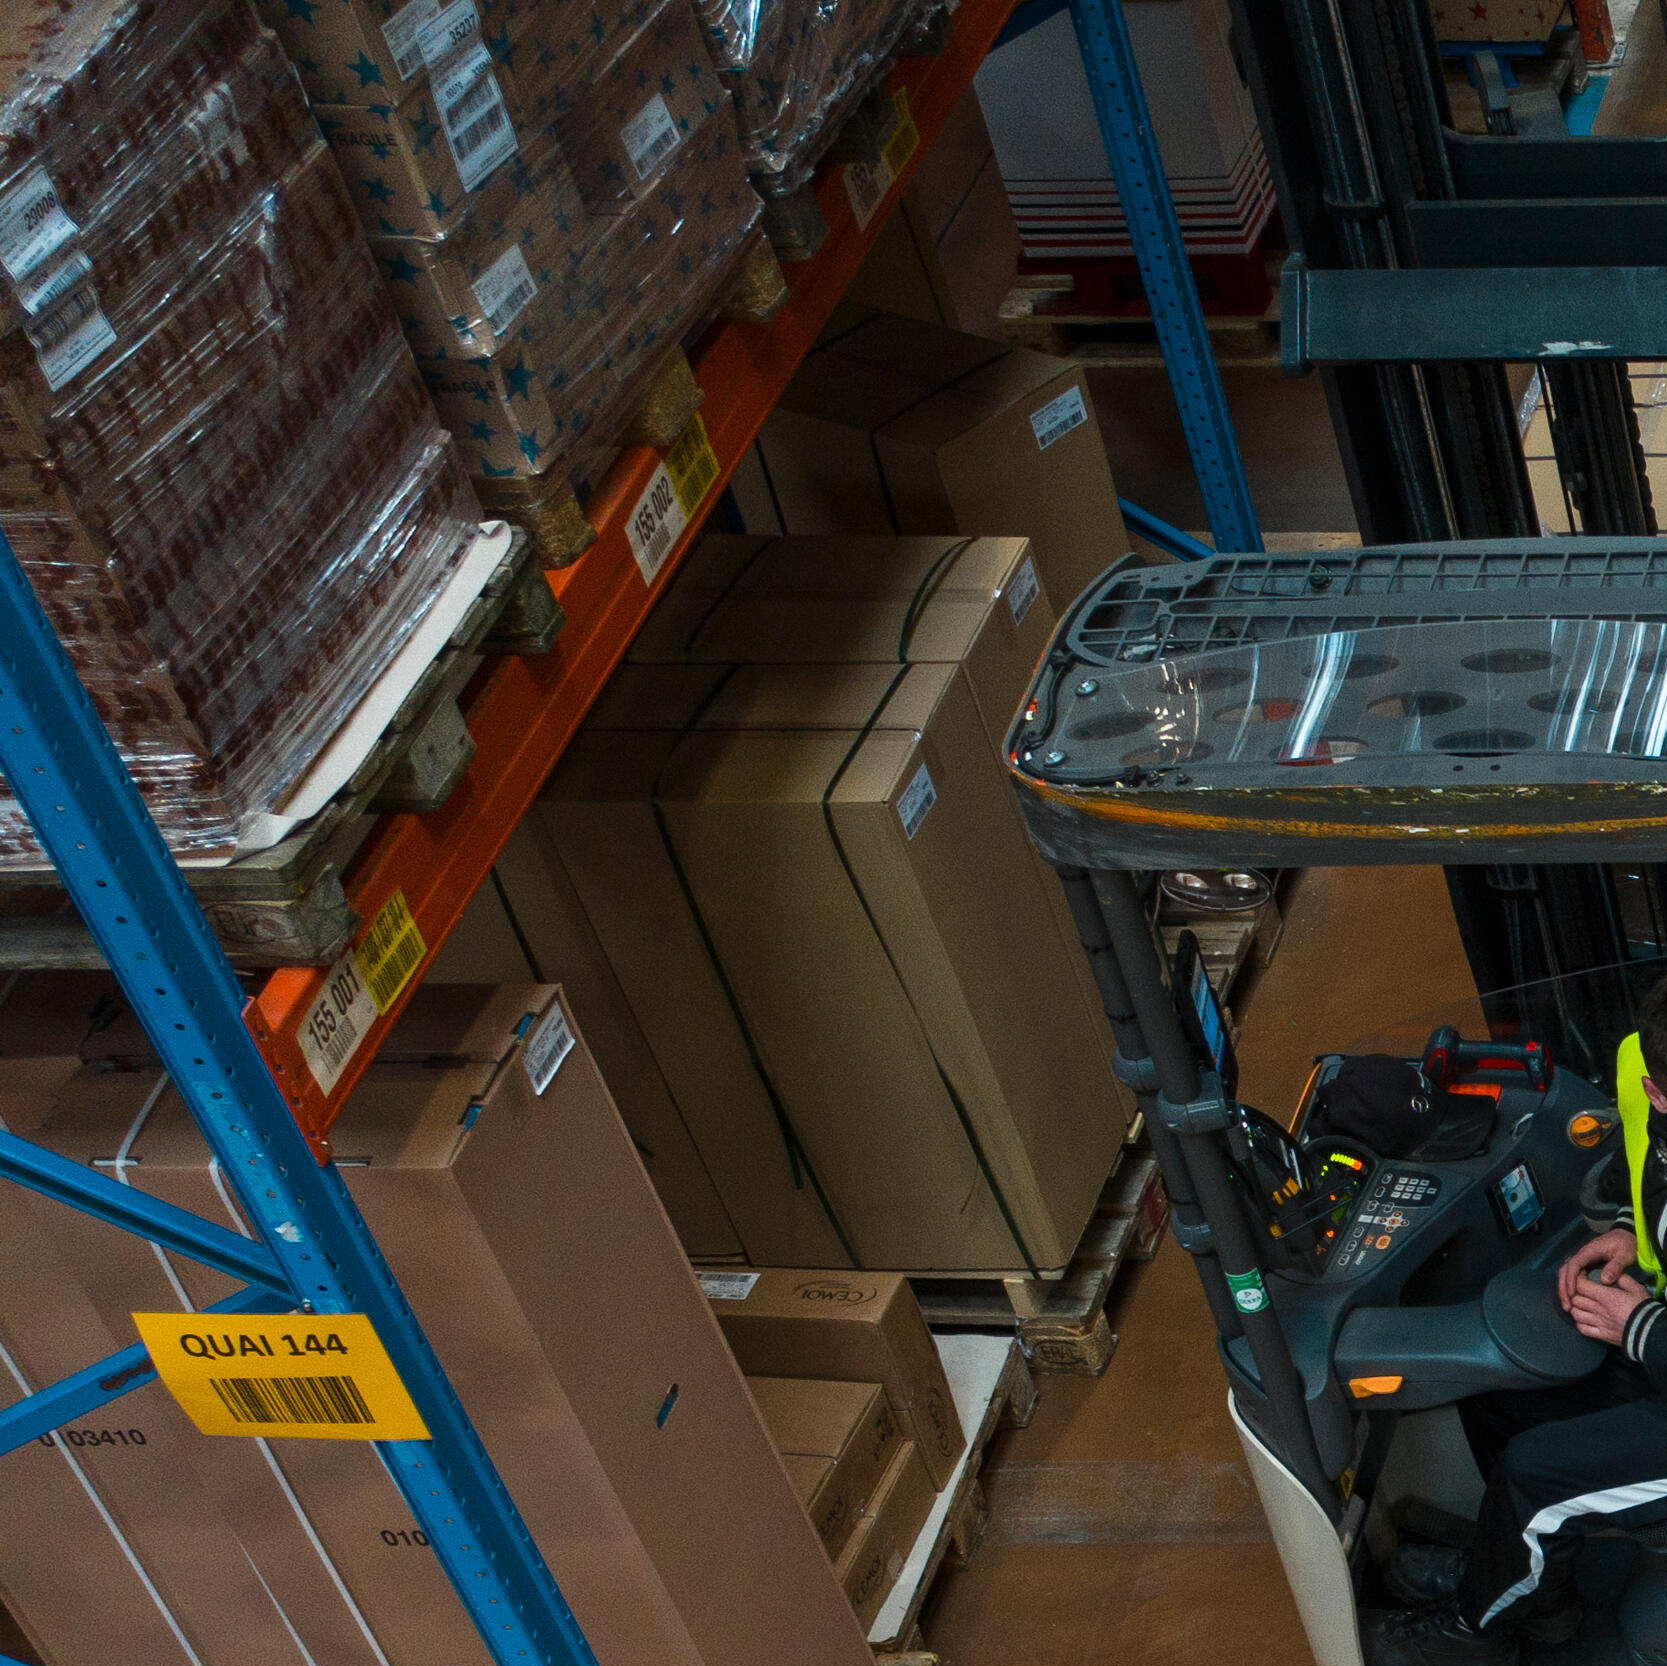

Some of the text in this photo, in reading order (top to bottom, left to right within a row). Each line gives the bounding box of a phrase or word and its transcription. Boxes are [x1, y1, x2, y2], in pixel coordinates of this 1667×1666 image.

[309, 963, 361, 1051] 155 001
[181, 1332, 349, 1359] QUAI 144
